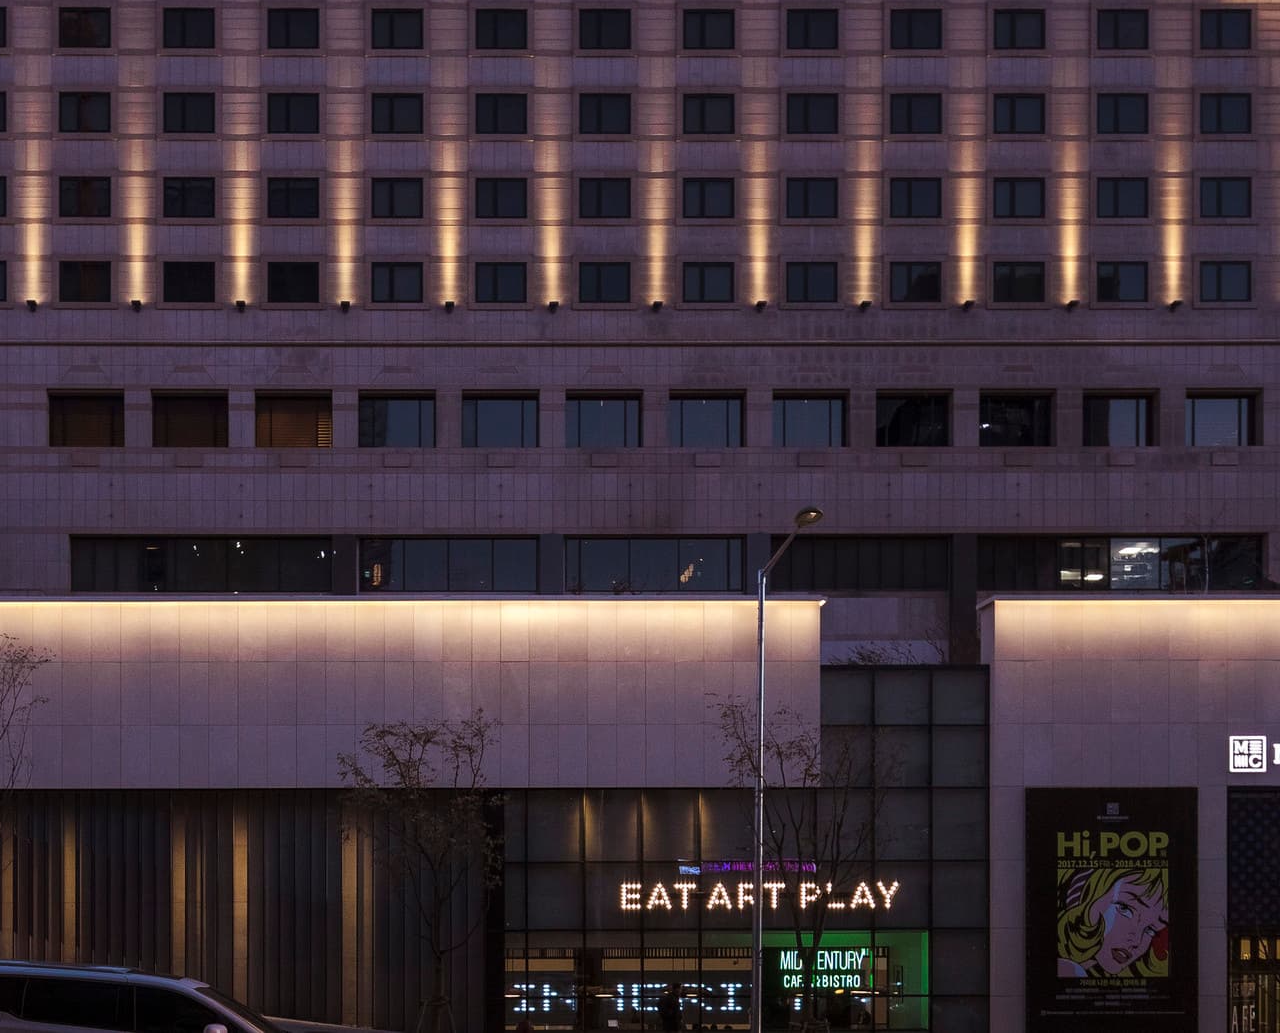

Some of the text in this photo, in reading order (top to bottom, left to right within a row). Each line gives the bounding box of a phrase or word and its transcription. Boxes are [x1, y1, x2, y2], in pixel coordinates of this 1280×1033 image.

[1057, 831, 1169, 859] Hi, POP
[620, 880, 900, 911] EAT ART PLAY
[816, 950, 865, 970] ENTURY
[783, 974, 805, 988] CAF
[822, 974, 861, 988] BISTRO
